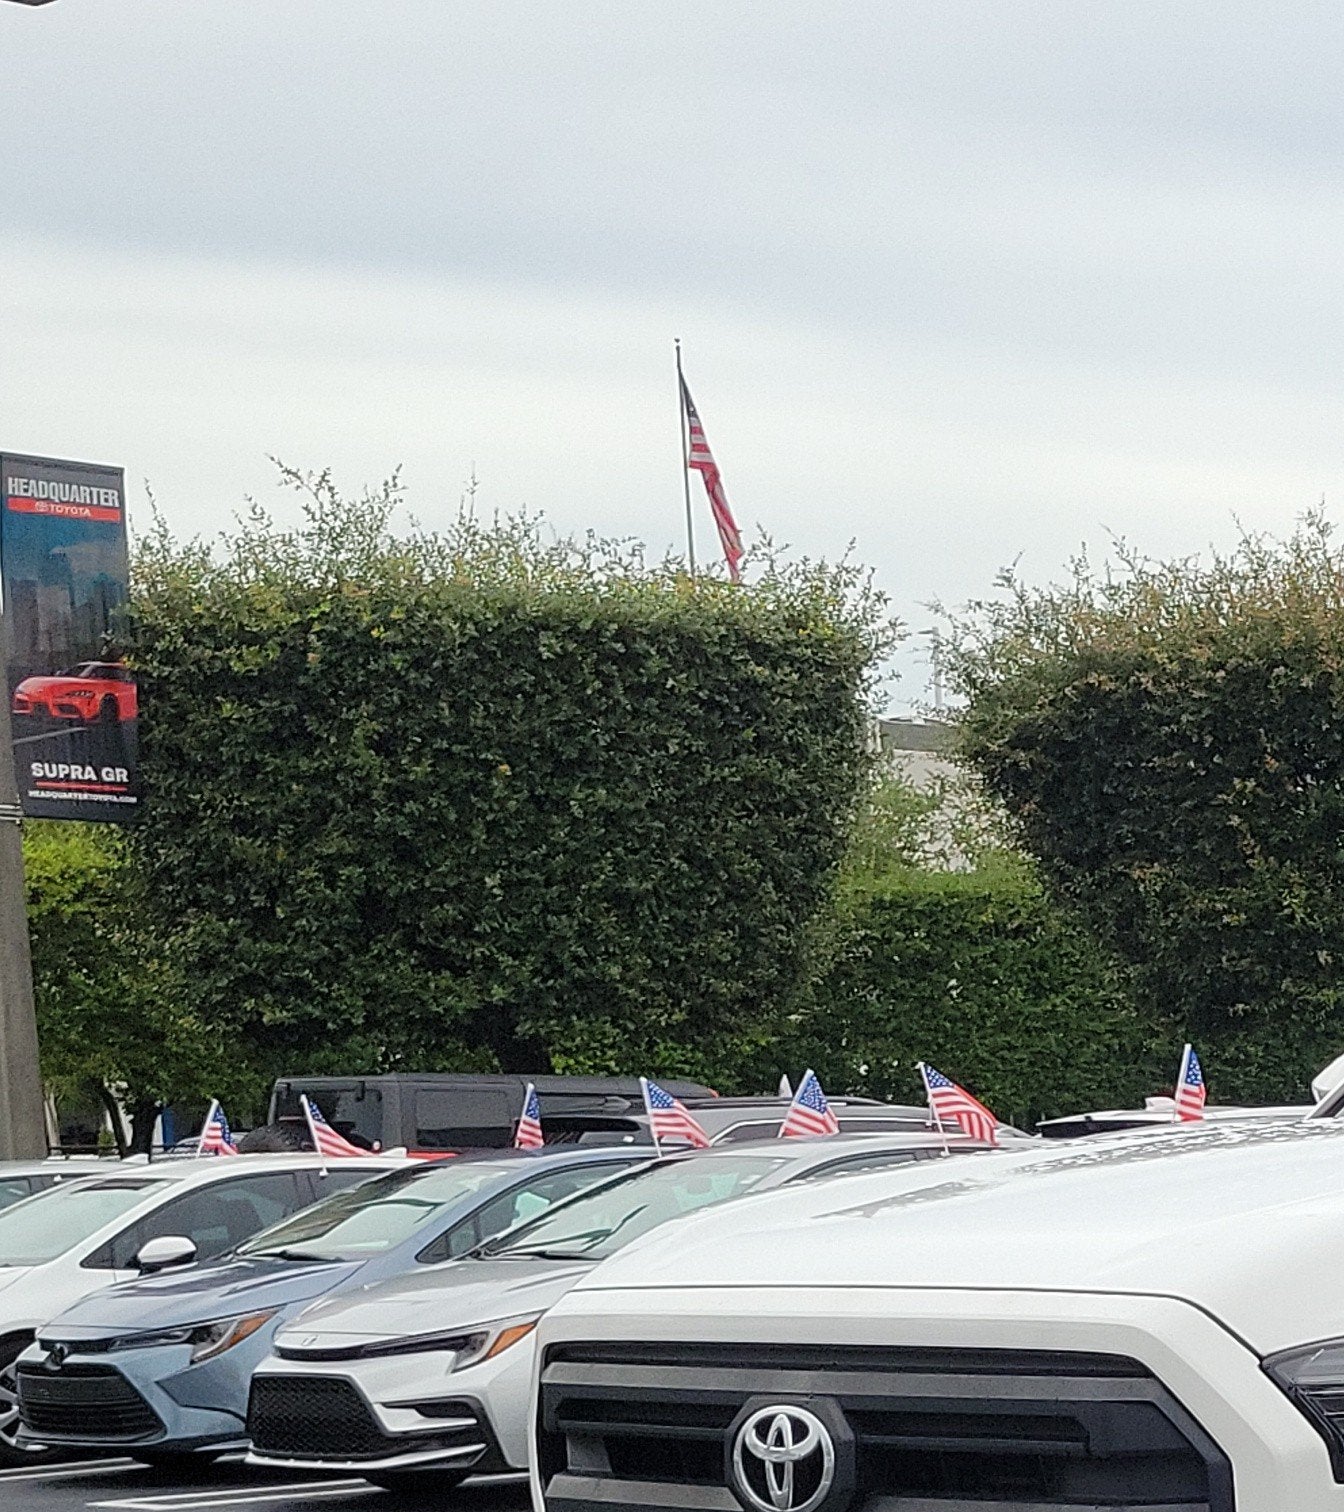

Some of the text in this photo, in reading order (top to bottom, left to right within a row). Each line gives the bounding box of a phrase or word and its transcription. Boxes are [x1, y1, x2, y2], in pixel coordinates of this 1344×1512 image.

[7, 477, 119, 507] HEADQUARTER
[49, 503, 92, 517] TOYOTA
[31, 762, 129, 782] SUPRA GR
